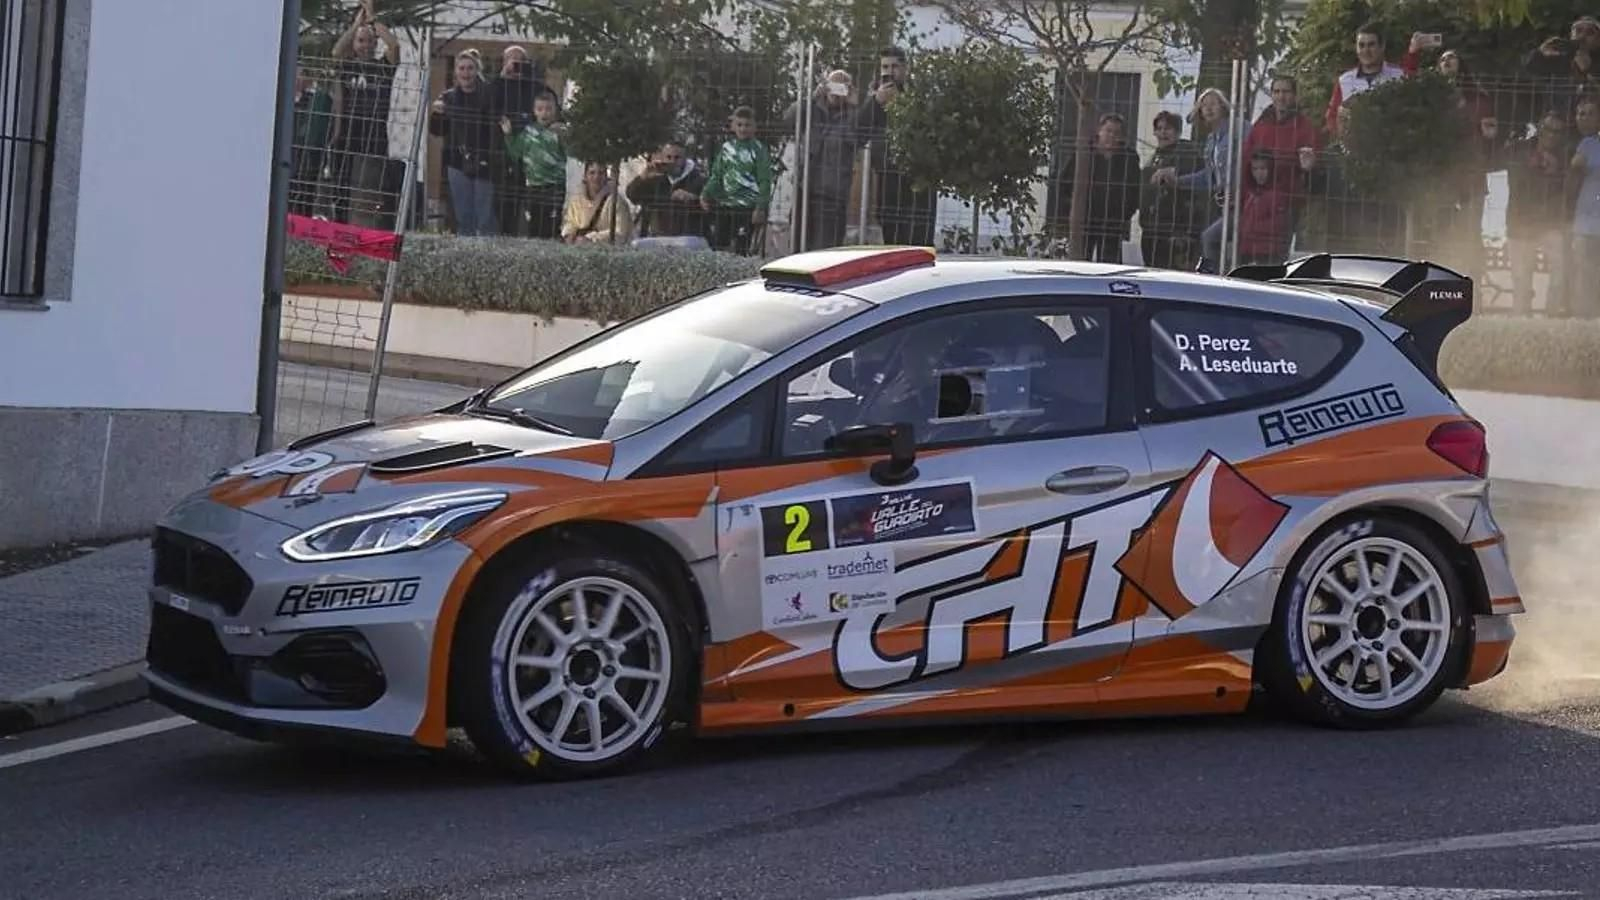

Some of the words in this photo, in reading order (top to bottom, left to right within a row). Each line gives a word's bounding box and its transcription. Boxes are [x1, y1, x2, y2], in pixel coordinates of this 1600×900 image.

[1430, 290, 1463, 300] PLEMAR
[1175, 334, 1195, 351] D.
[1198, 334, 1252, 352] Perez
[1179, 353, 1198, 371] A.
[1201, 354, 1298, 374] Leseduarte
[871, 499, 921, 522] VALLE
[874, 504, 944, 533] GUADIATO
[784, 504, 812, 553] 2
[827, 557, 888, 576] trademet
